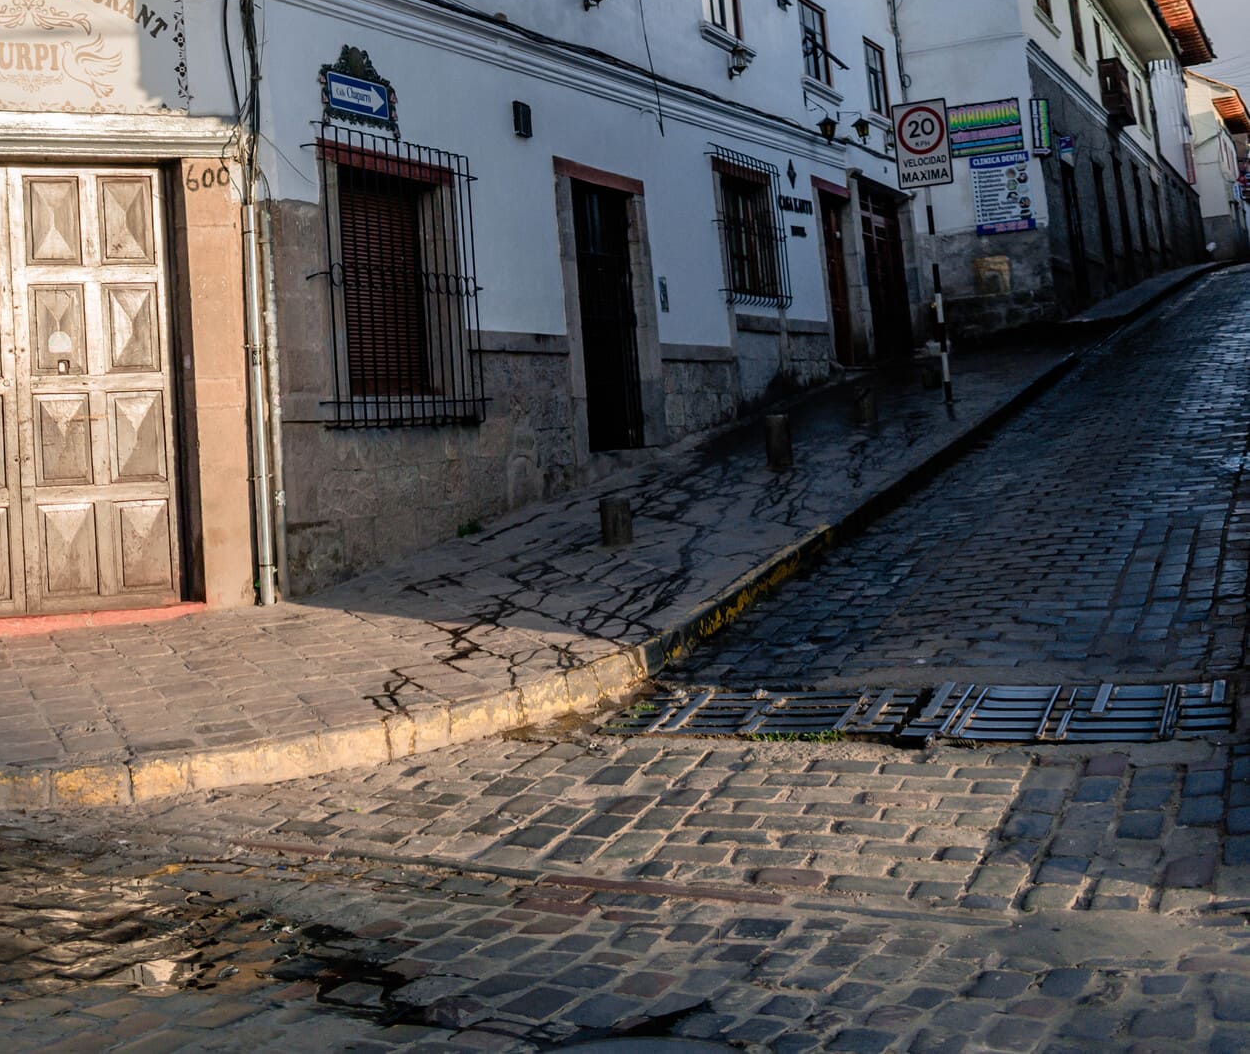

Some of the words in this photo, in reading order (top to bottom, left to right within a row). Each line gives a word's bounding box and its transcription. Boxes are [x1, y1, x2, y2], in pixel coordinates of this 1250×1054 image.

[949, 100, 1018, 130] BORDADOS
[908, 118, 935, 138] 20
[903, 154, 947, 168] VELOCIDAD
[1001, 153, 1027, 163] DENTAL
[186, 164, 230, 192] 600
[902, 168, 949, 184] MAXIMA
